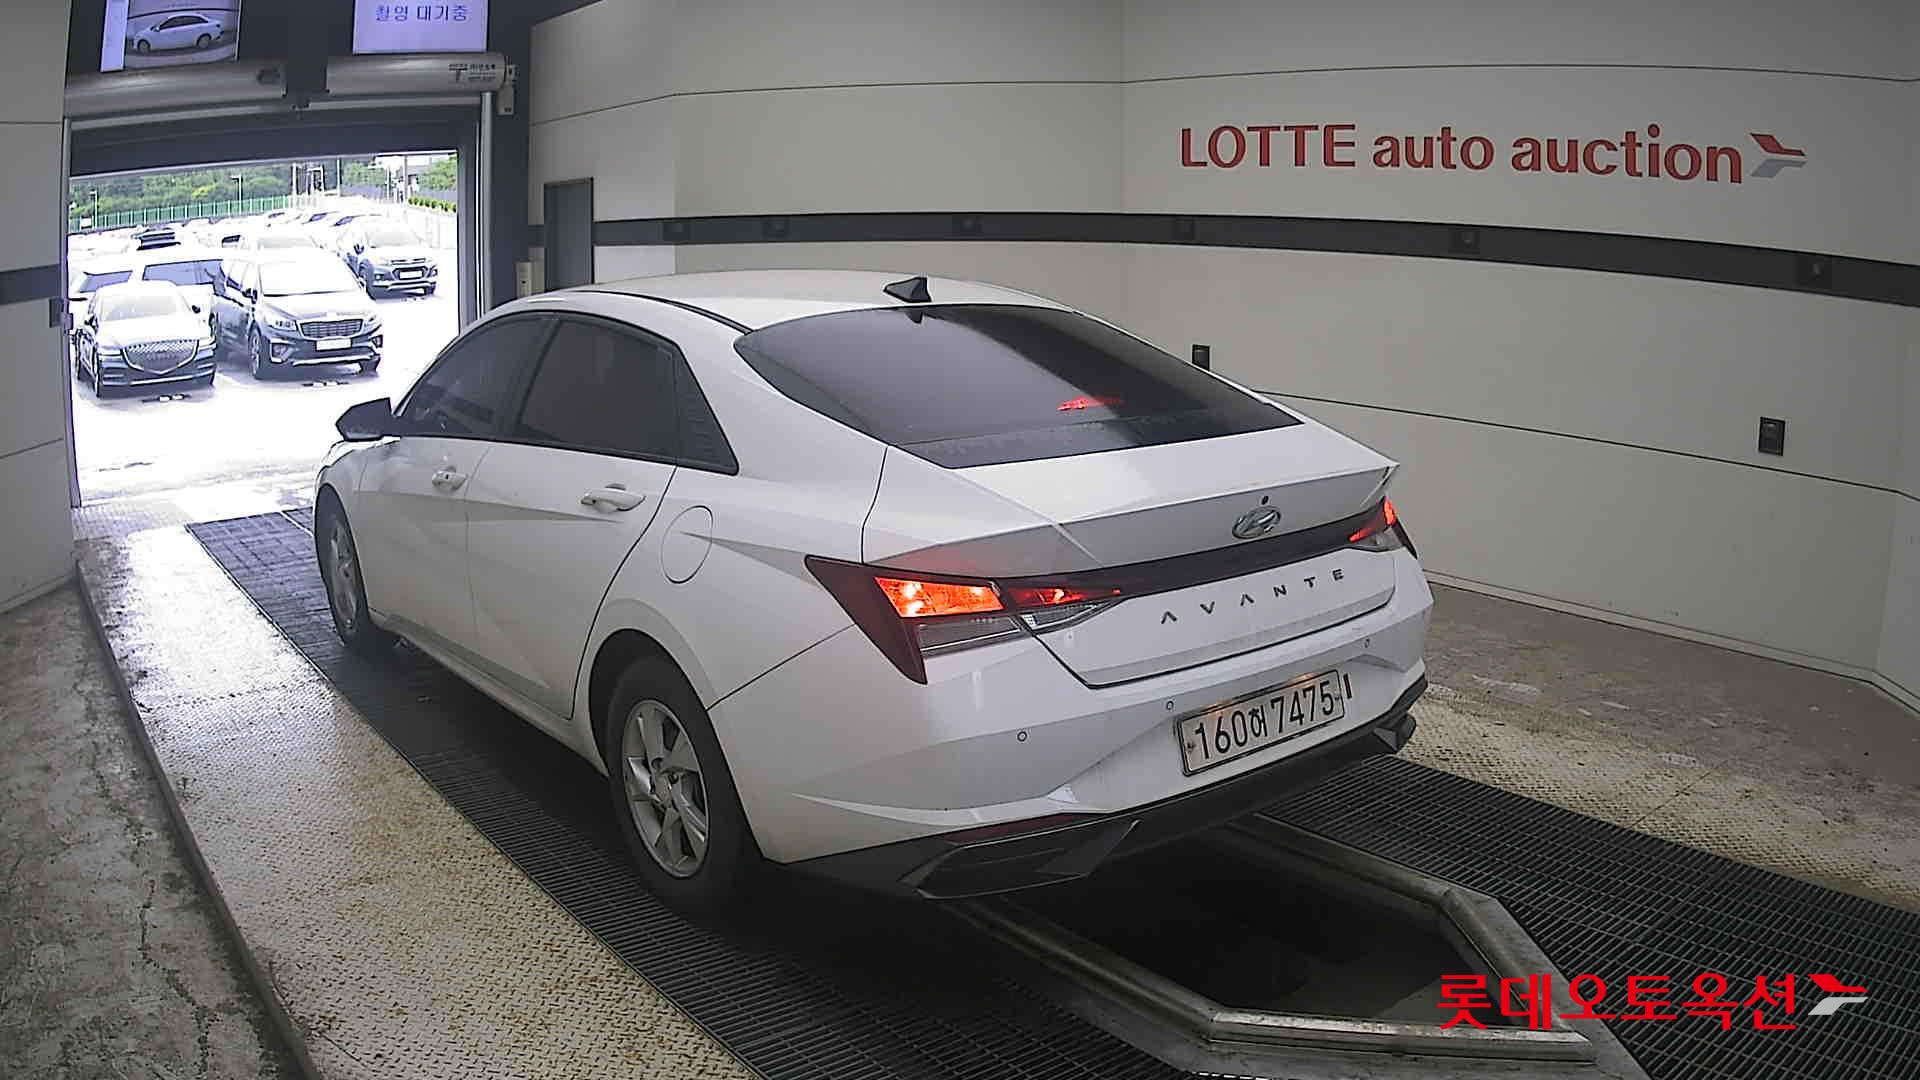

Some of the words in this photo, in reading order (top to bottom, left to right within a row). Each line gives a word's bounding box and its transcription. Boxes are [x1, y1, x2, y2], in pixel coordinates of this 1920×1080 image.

[417, 5, 468, 22] 대기중
[1181, 124, 1356, 168] LOTTE
[1372, 126, 1495, 169] auto
[1511, 123, 1743, 184] auction
[1160, 568, 1345, 625] AVANTE
[1194, 680, 1338, 760] 160허7475
